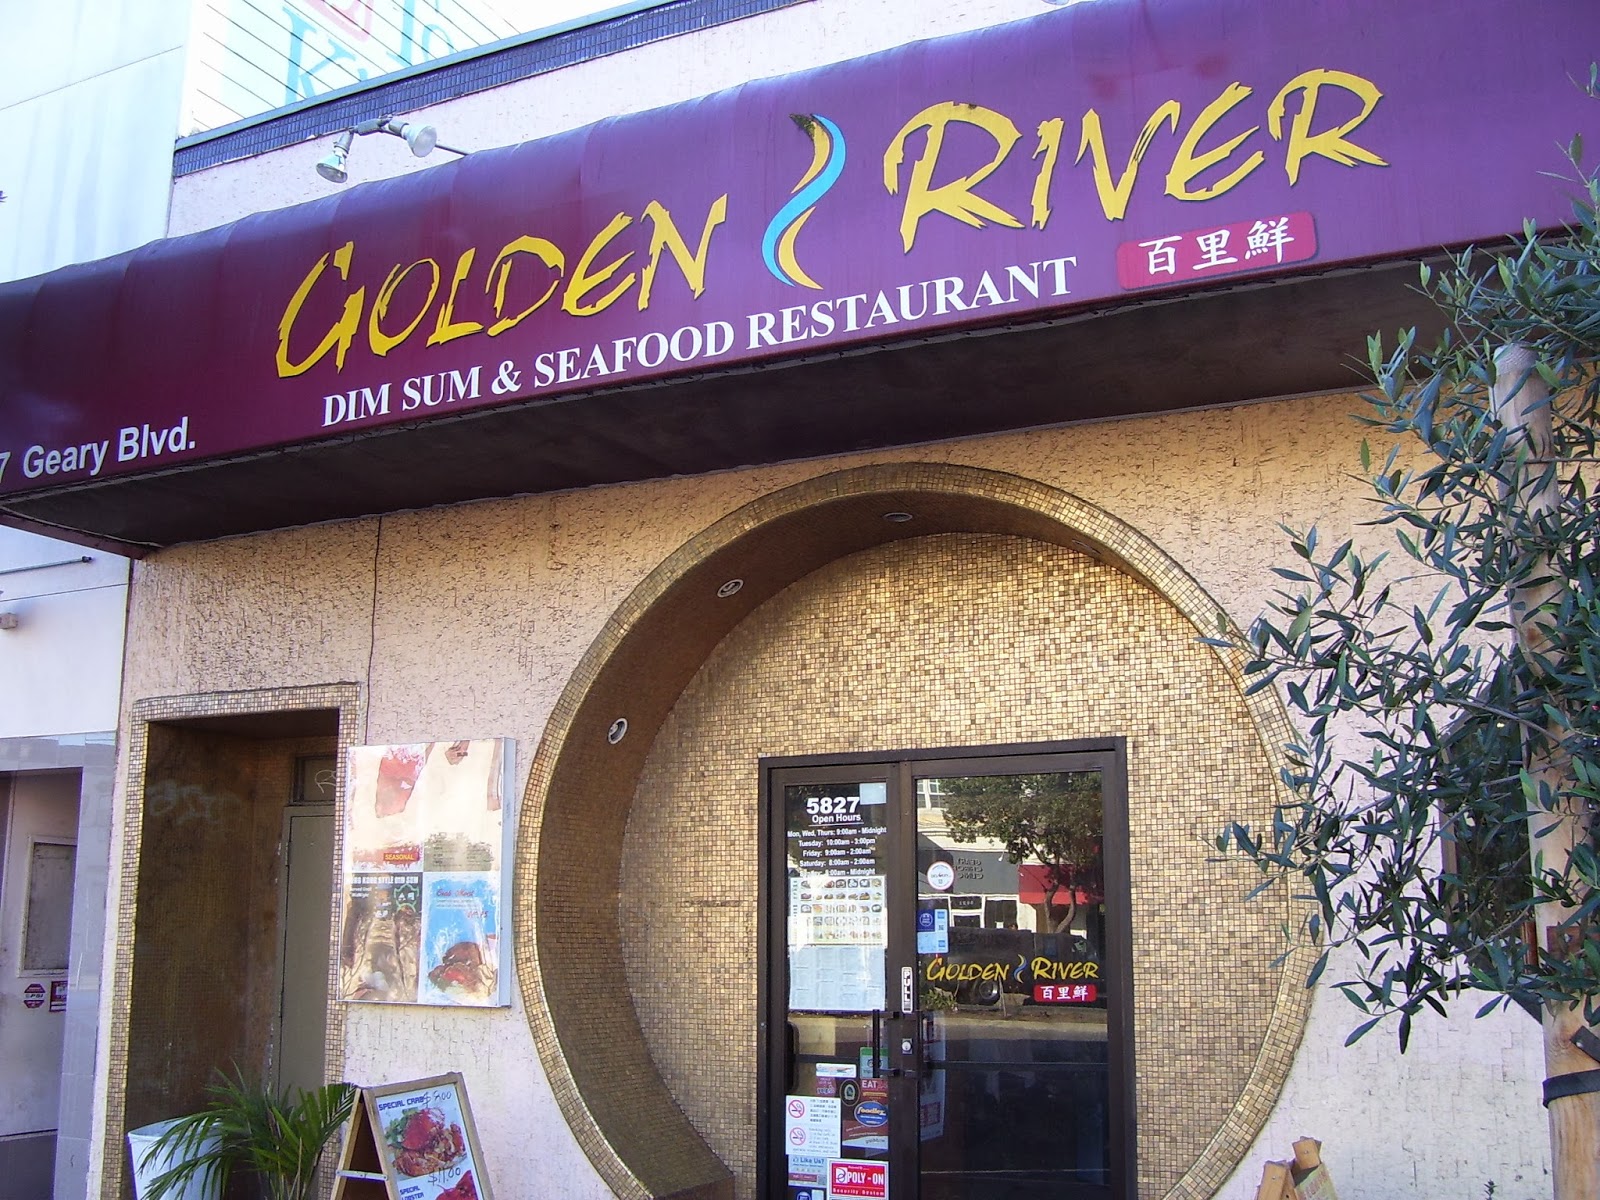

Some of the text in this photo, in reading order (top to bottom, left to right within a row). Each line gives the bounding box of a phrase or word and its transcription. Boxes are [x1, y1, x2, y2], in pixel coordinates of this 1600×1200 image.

[275, 68, 1389, 379] GOLDEN RIVER
[1139, 216, 1294, 276] 百里鮮
[322, 256, 1077, 428] DIM SUM & SEAFOOD RESTAURANT
[23, 440, 109, 479] Geary
[118, 416, 196, 462] Blvd.
[806, 796, 860, 814] 5827
[812, 813, 861, 825] Open Hours
[861, 827, 887, 835] Midnight
[384, 853, 414, 861] SEASONAL
[926, 957, 1099, 981] GOLDEN RIVER
[1040, 985, 1089, 1000] 百里鮮
[378, 1100, 405, 1111] SPECIAL
[400, 1186, 421, 1195] SPECIAL
